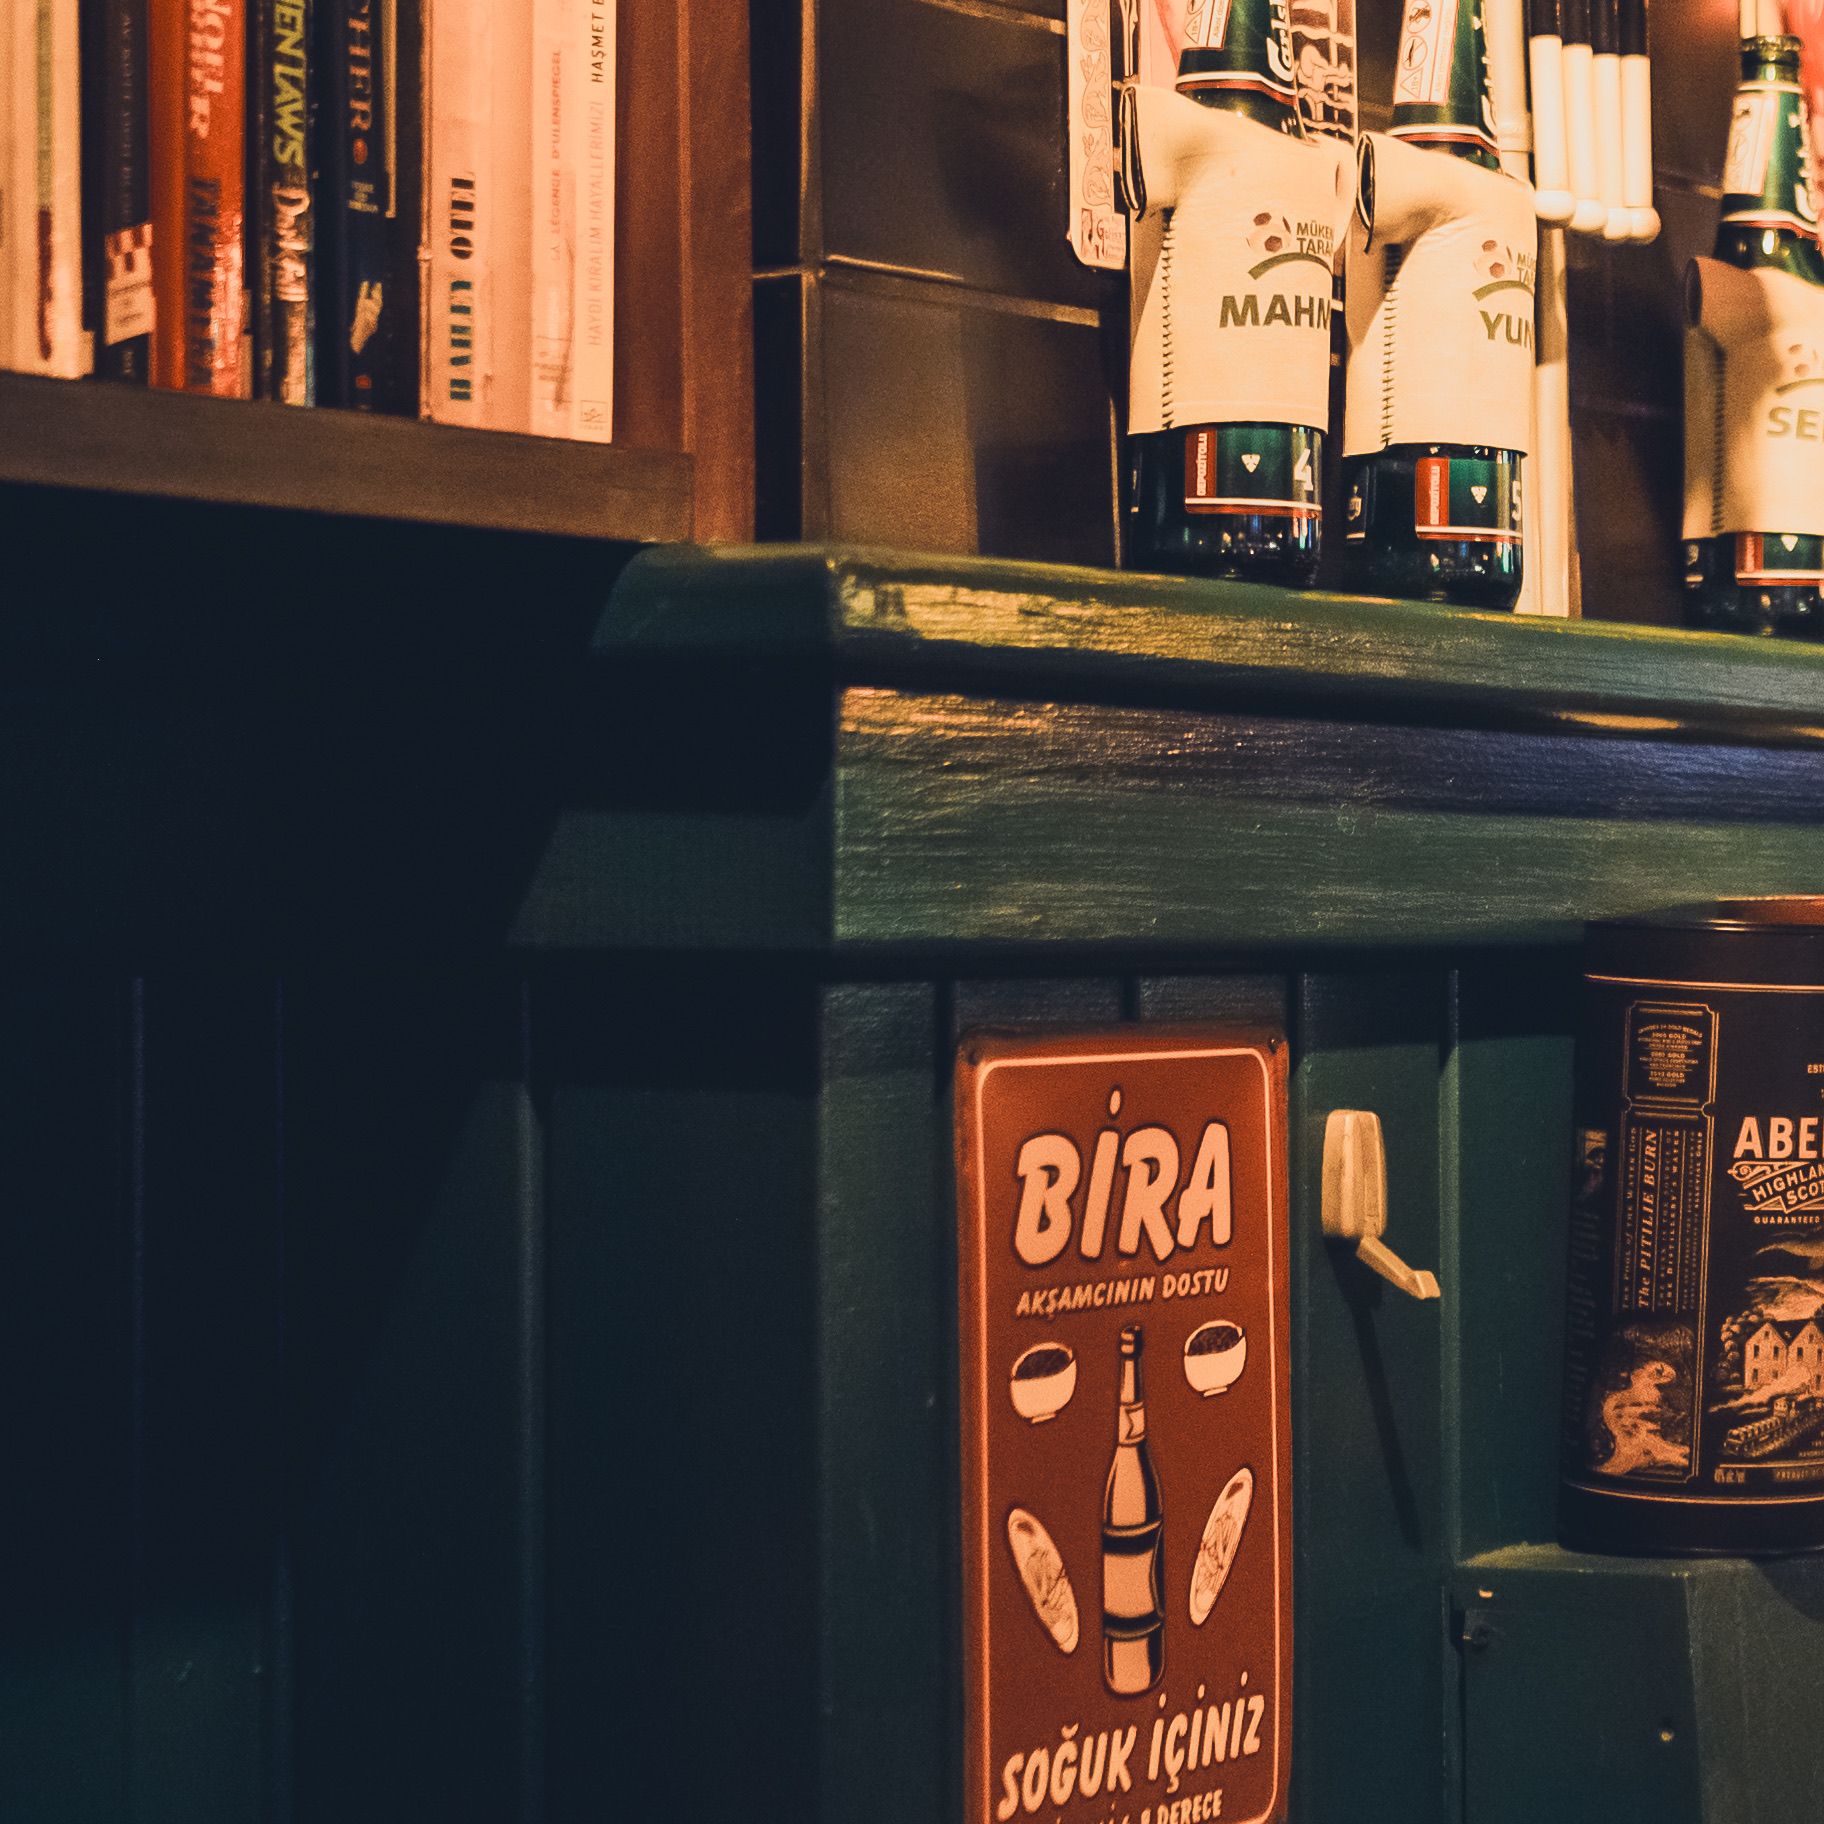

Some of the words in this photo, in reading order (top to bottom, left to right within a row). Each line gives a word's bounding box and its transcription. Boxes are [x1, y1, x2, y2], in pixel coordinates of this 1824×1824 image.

[589, 12, 607, 84] HAŞMET
[272, 56, 306, 169] LAWS
[1293, 448, 1314, 492] 4
[1013, 1088, 1233, 1266] BİRA
[1643, 1128, 1658, 1187] BURN
[1640, 1192, 1655, 1271] PITILIE
[1015, 1274, 1156, 1321] AKŞAMCININ
[1161, 1267, 1231, 1301] DOSTU
[1638, 1276, 1651, 1308] The
[997, 1722, 1138, 1822] SOĞUK
[1147, 1670, 1266, 1794] İÇİNİZ
